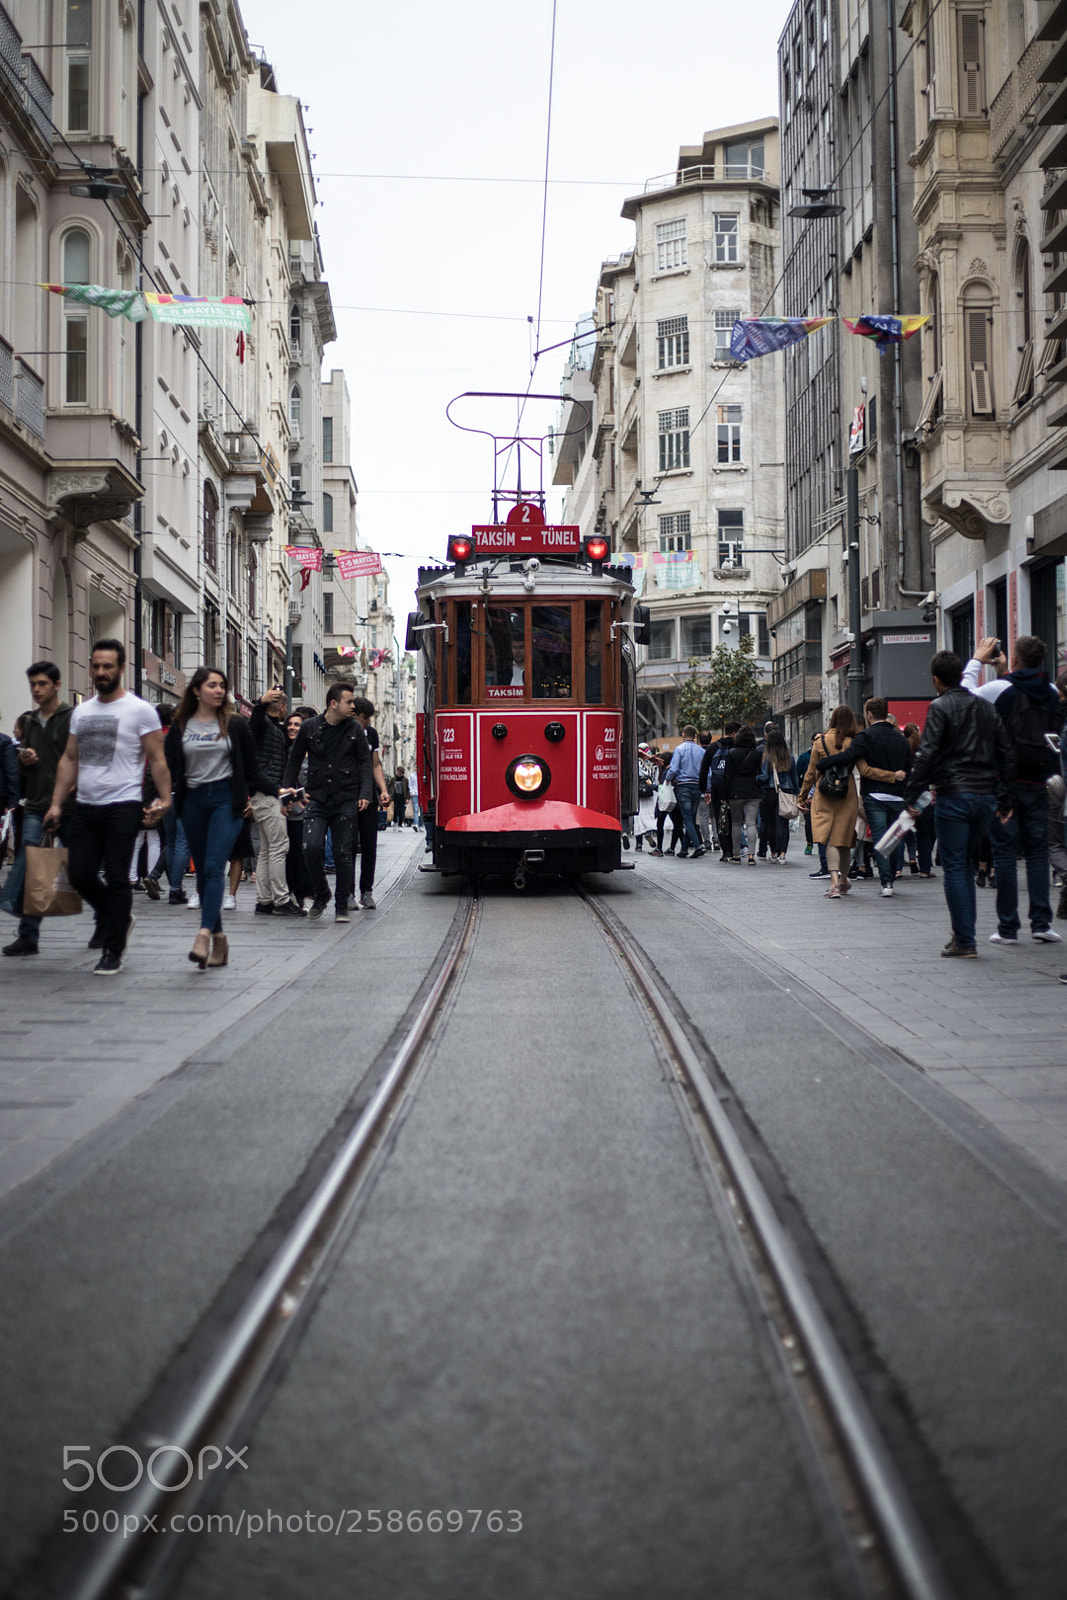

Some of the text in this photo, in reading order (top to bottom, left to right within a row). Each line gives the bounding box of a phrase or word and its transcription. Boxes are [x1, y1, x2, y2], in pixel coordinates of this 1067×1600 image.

[521, 505, 530, 523] 2
[475, 528, 516, 546] TAKSİM
[541, 527, 577, 545] TÜNEL
[488, 688, 524, 697] TAKSİM
[443, 728, 455, 742] 223
